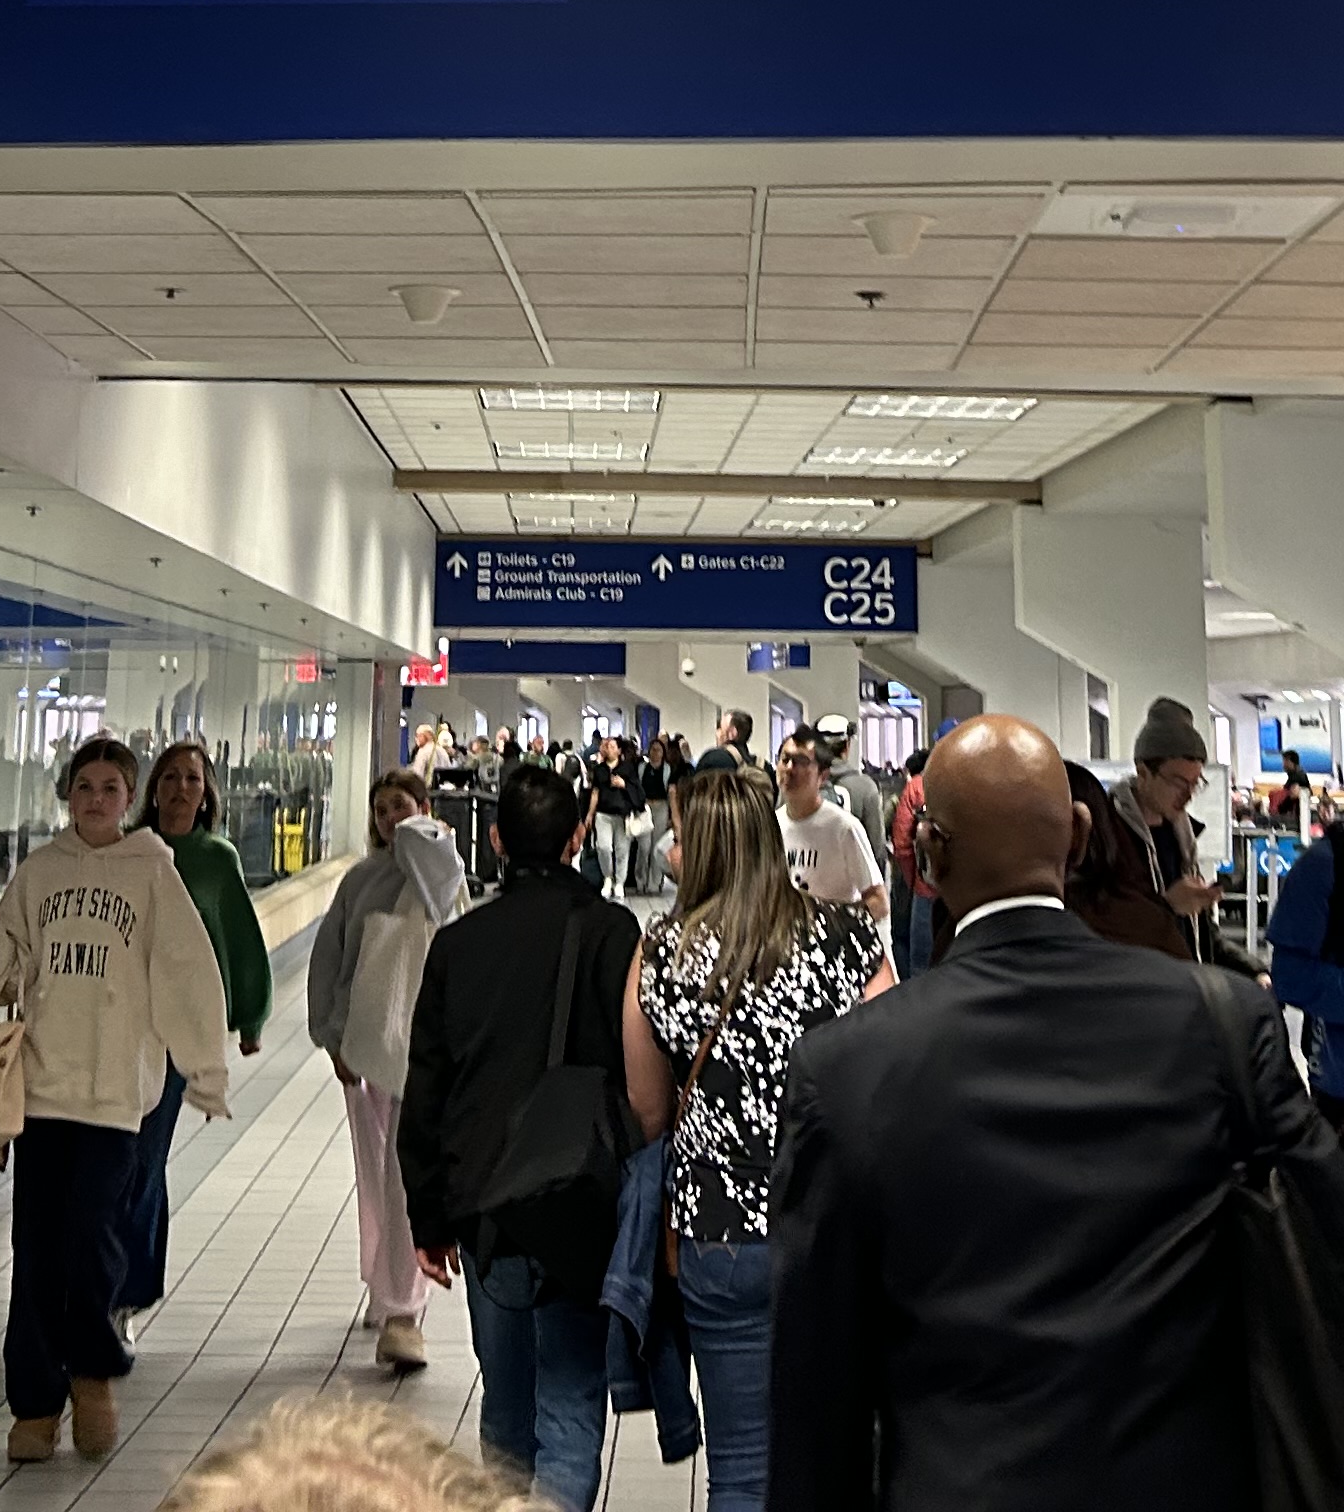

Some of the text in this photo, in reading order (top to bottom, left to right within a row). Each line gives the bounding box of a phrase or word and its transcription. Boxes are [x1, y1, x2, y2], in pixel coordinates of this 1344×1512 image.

[495, 552, 539, 568] Toilets
[698, 554, 737, 570] Gates
[494, 569, 642, 588] Ground Transportation
[823, 556, 895, 590] C24
[494, 586, 553, 601] Admirals
[556, 586, 587, 602] Club
[823, 591, 896, 626] C25
[49, 941, 110, 978] HAWAII
